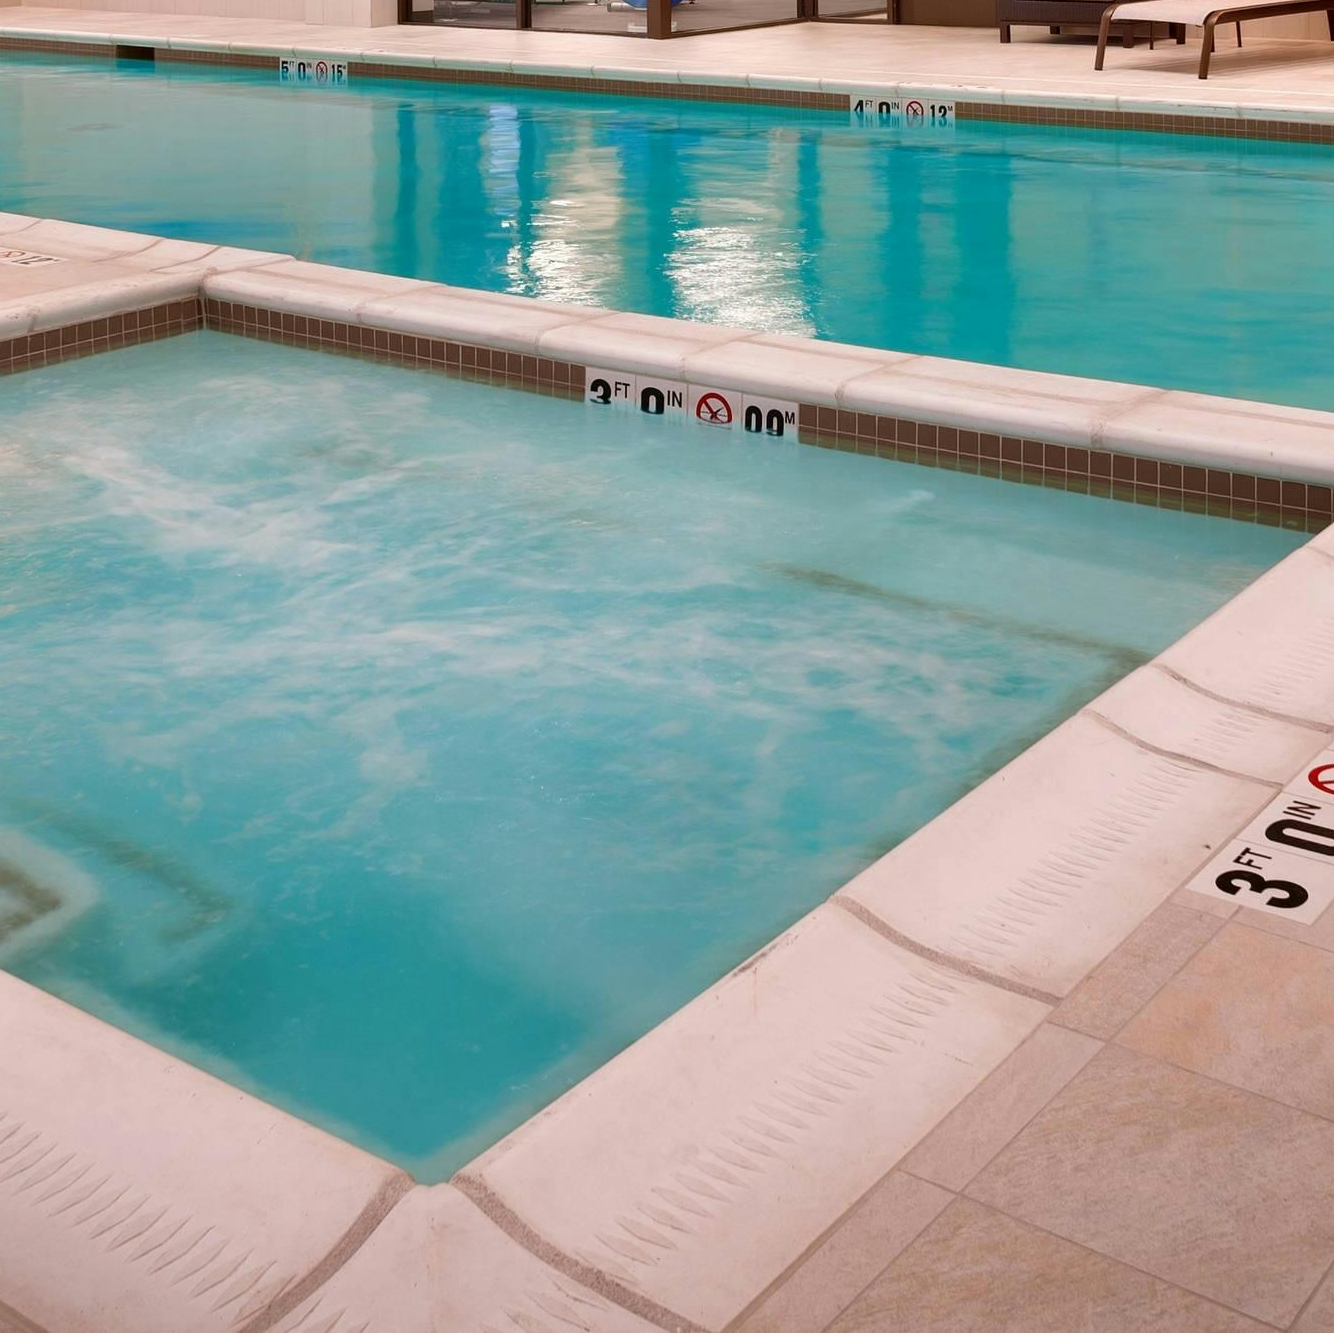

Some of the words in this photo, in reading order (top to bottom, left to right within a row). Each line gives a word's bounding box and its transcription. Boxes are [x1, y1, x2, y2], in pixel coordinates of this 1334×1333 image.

[614, 381, 630, 398] FT
[667, 390, 682, 408] IN
[1283, 800, 1321, 820] IN
[1233, 847, 1272, 870] FT
[1215, 869, 1309, 909] 3
